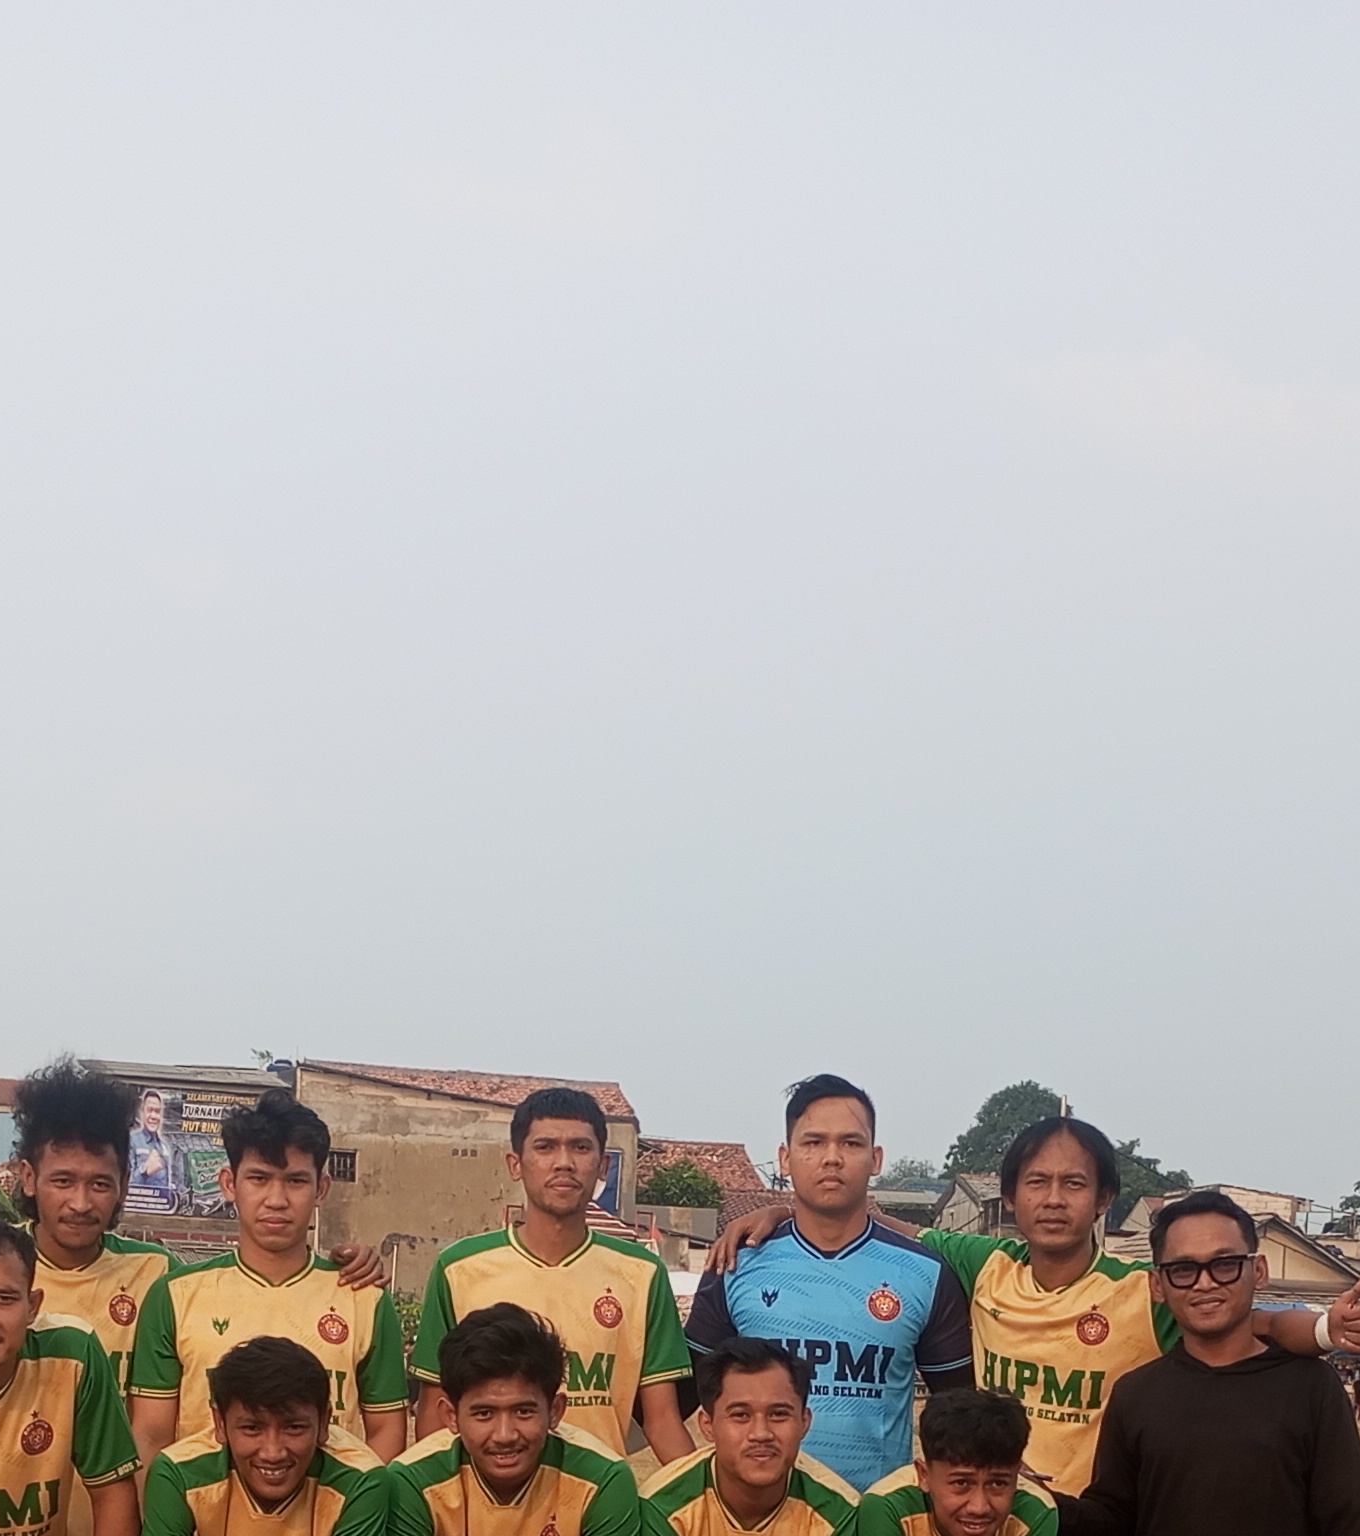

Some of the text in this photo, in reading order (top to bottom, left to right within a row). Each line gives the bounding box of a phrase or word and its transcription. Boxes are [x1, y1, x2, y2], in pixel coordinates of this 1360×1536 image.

[183, 1105, 221, 1117] TURNAM
[181, 1120, 200, 1133] HUT
[982, 1347, 1106, 1410] HIPMI
[833, 1386, 883, 1399] SELATAN
[1037, 1408, 1090, 1424] SELATAN
